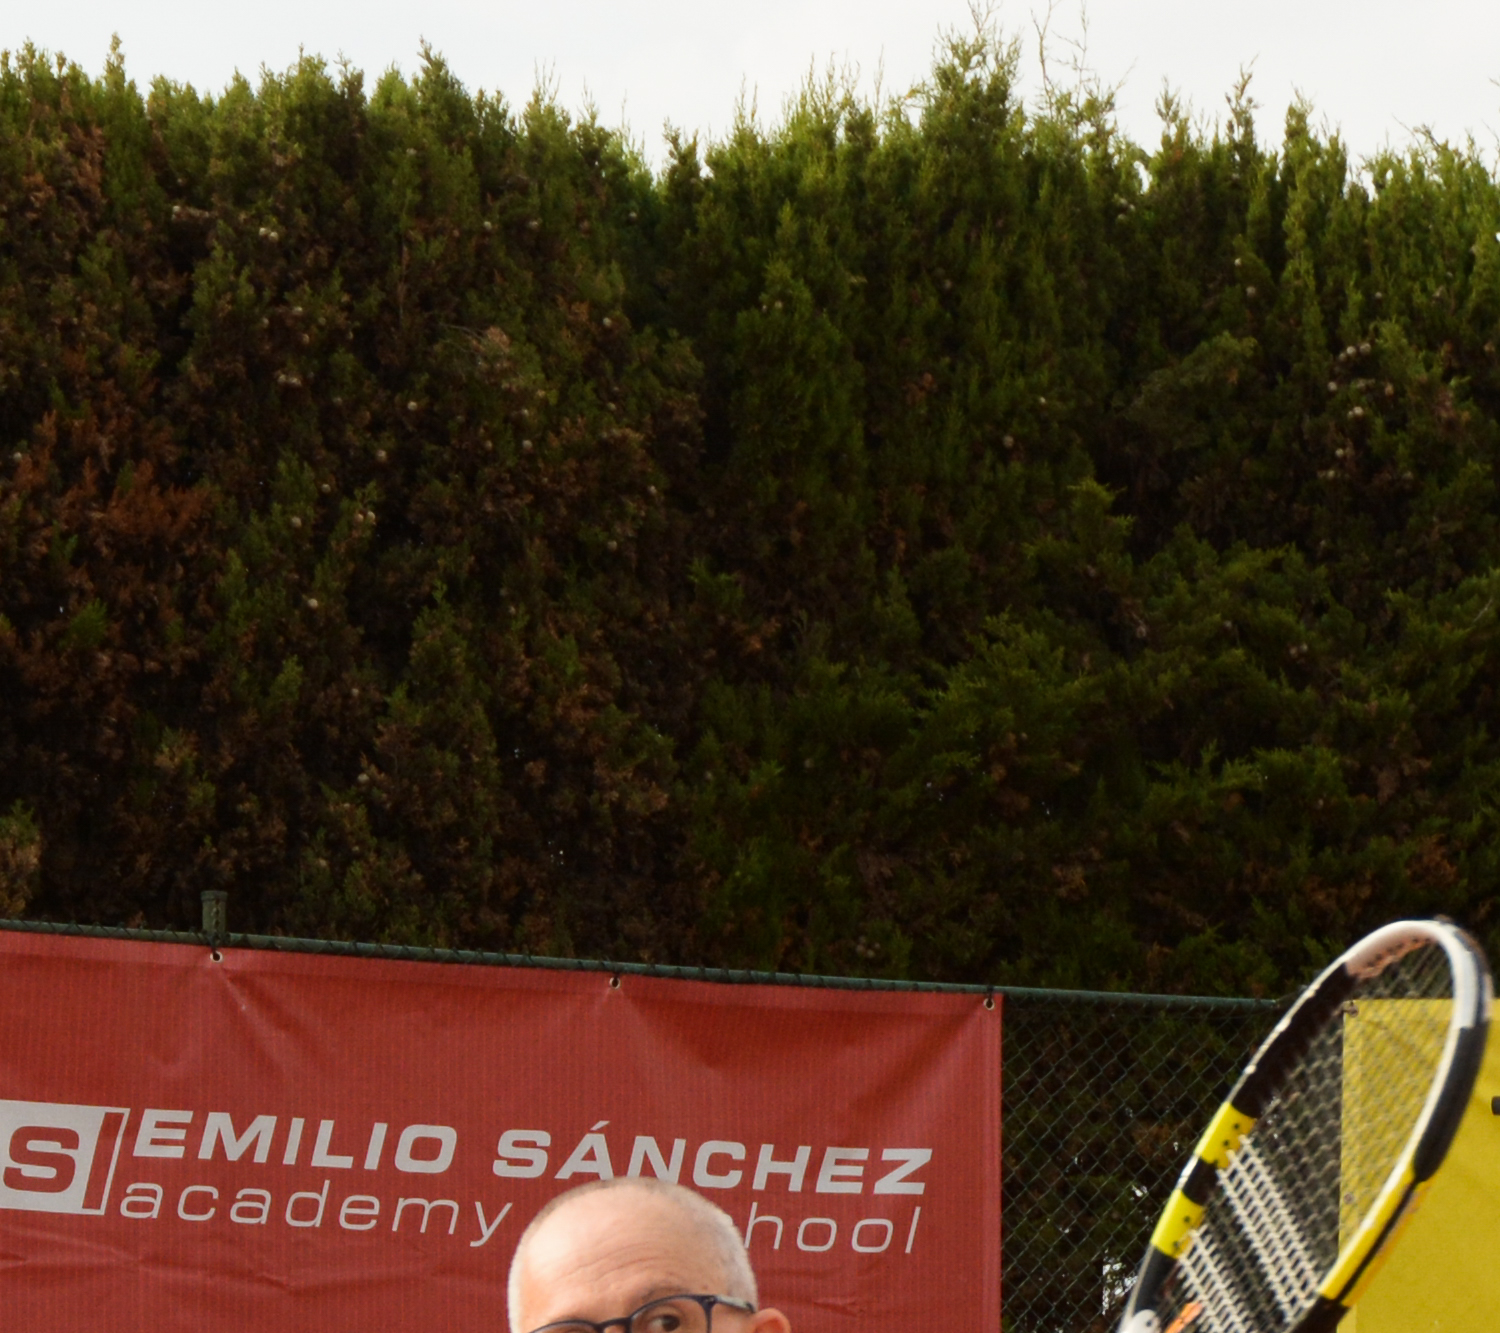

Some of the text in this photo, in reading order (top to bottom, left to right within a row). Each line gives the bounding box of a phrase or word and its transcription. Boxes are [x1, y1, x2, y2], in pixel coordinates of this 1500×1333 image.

[132, 1107, 933, 1196] EMILIO SÁNCHEZ
[119, 1180, 922, 1254] academy hool
